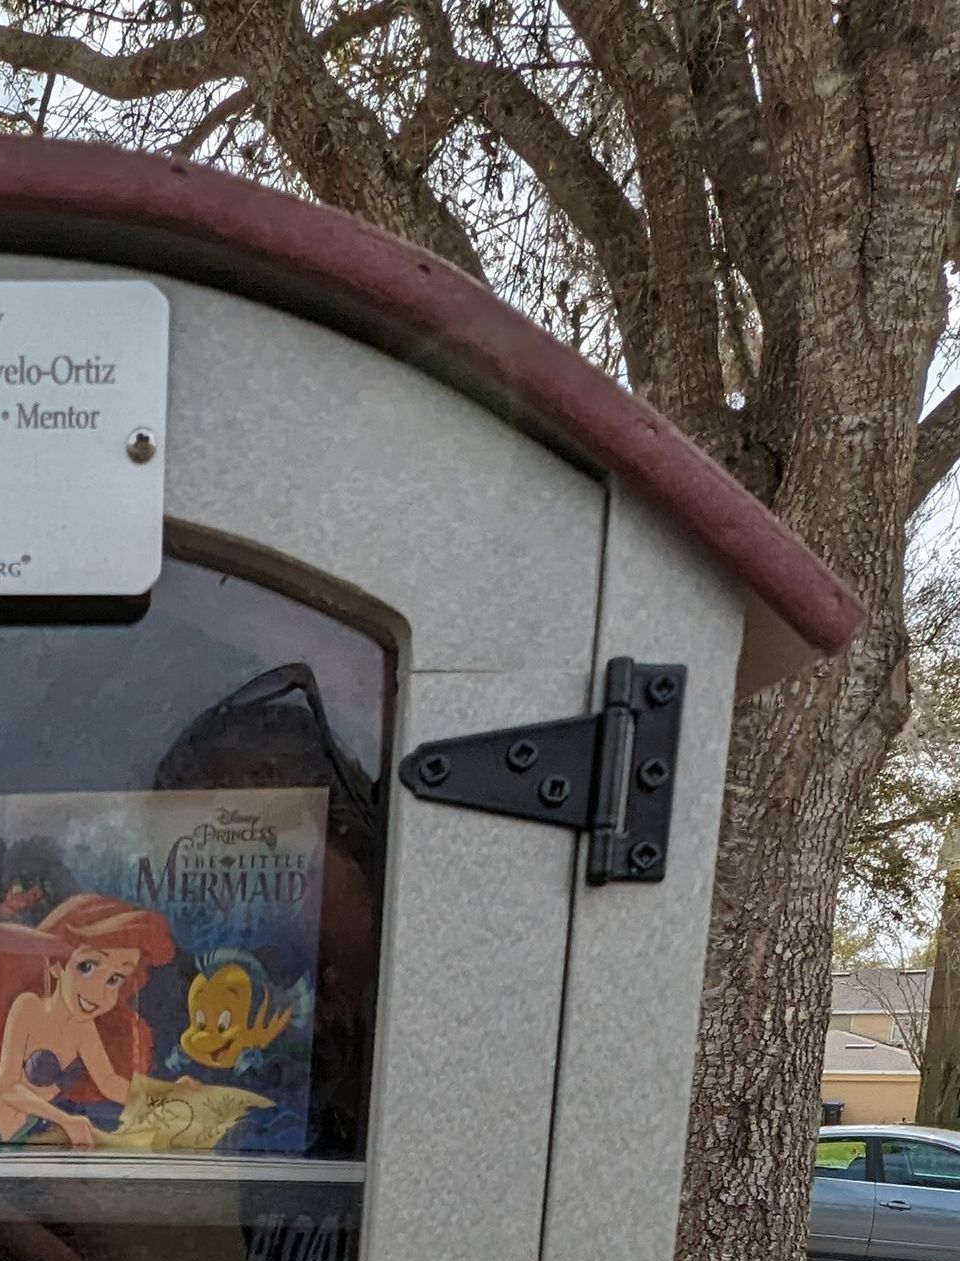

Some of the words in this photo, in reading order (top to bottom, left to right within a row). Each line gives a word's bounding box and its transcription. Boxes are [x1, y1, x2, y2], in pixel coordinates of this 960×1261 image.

[16, 404, 100, 430] Mentor
[137, 835, 307, 908] MERMAID
[183, 855, 217, 869] THE
[240, 855, 305, 869] LITTLE
